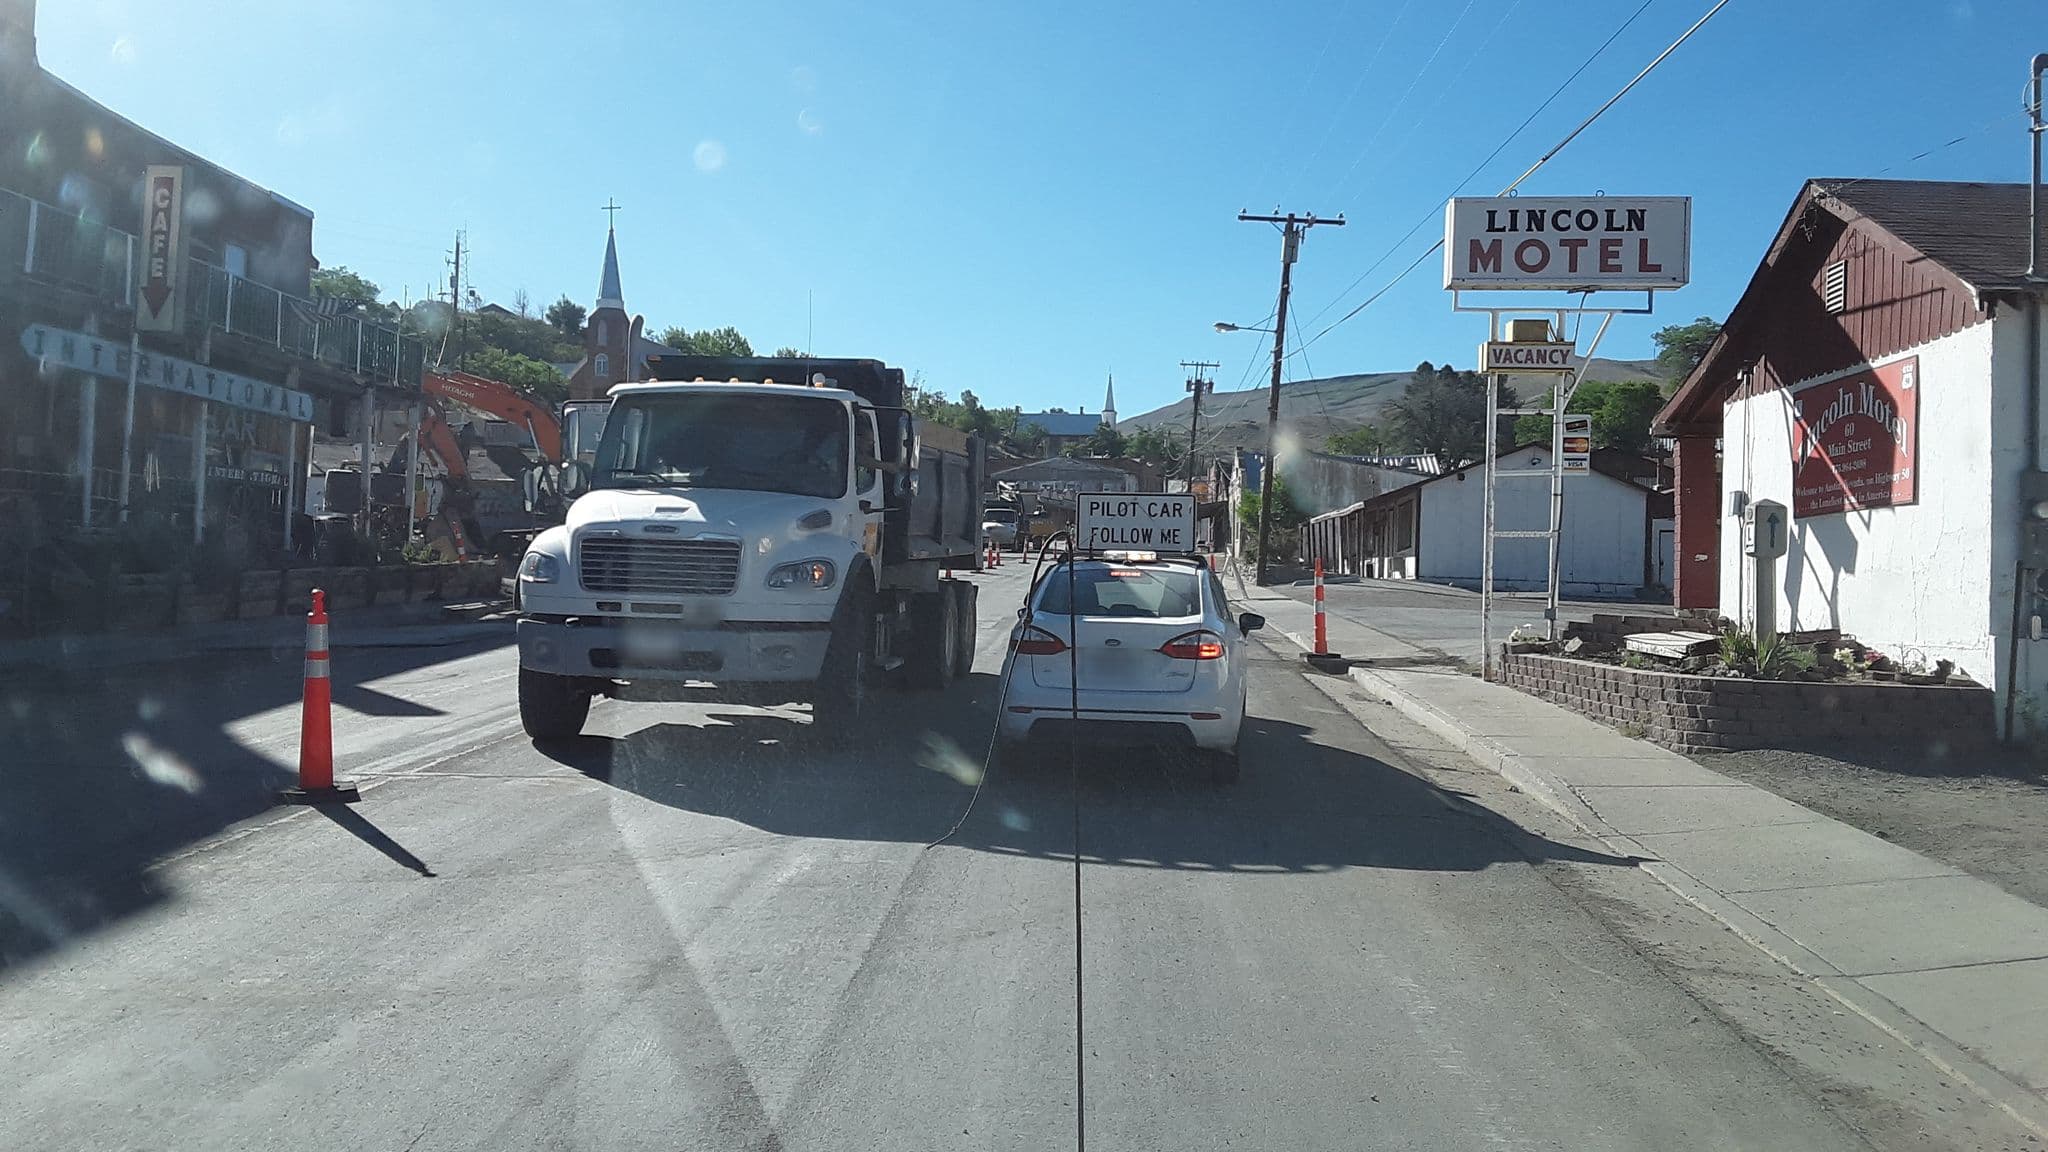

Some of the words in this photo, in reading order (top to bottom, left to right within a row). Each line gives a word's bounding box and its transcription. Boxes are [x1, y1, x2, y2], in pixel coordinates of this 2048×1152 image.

[1486, 209, 1647, 232] LINCOLN
[152, 188, 170, 278] CAFE
[1469, 238, 1662, 273] MOTEL
[1492, 349, 1571, 365] VACANCY
[1858, 382, 1908, 458] Motel
[1827, 442, 1846, 457] Main
[1847, 438, 1872, 455] Street
[1901, 468, 1910, 480] 50
[1090, 501, 1139, 517] PILOT
[1147, 502, 1183, 518] CAR
[1091, 527, 1153, 544] FOLLOW
[1160, 528, 1181, 545] ME
